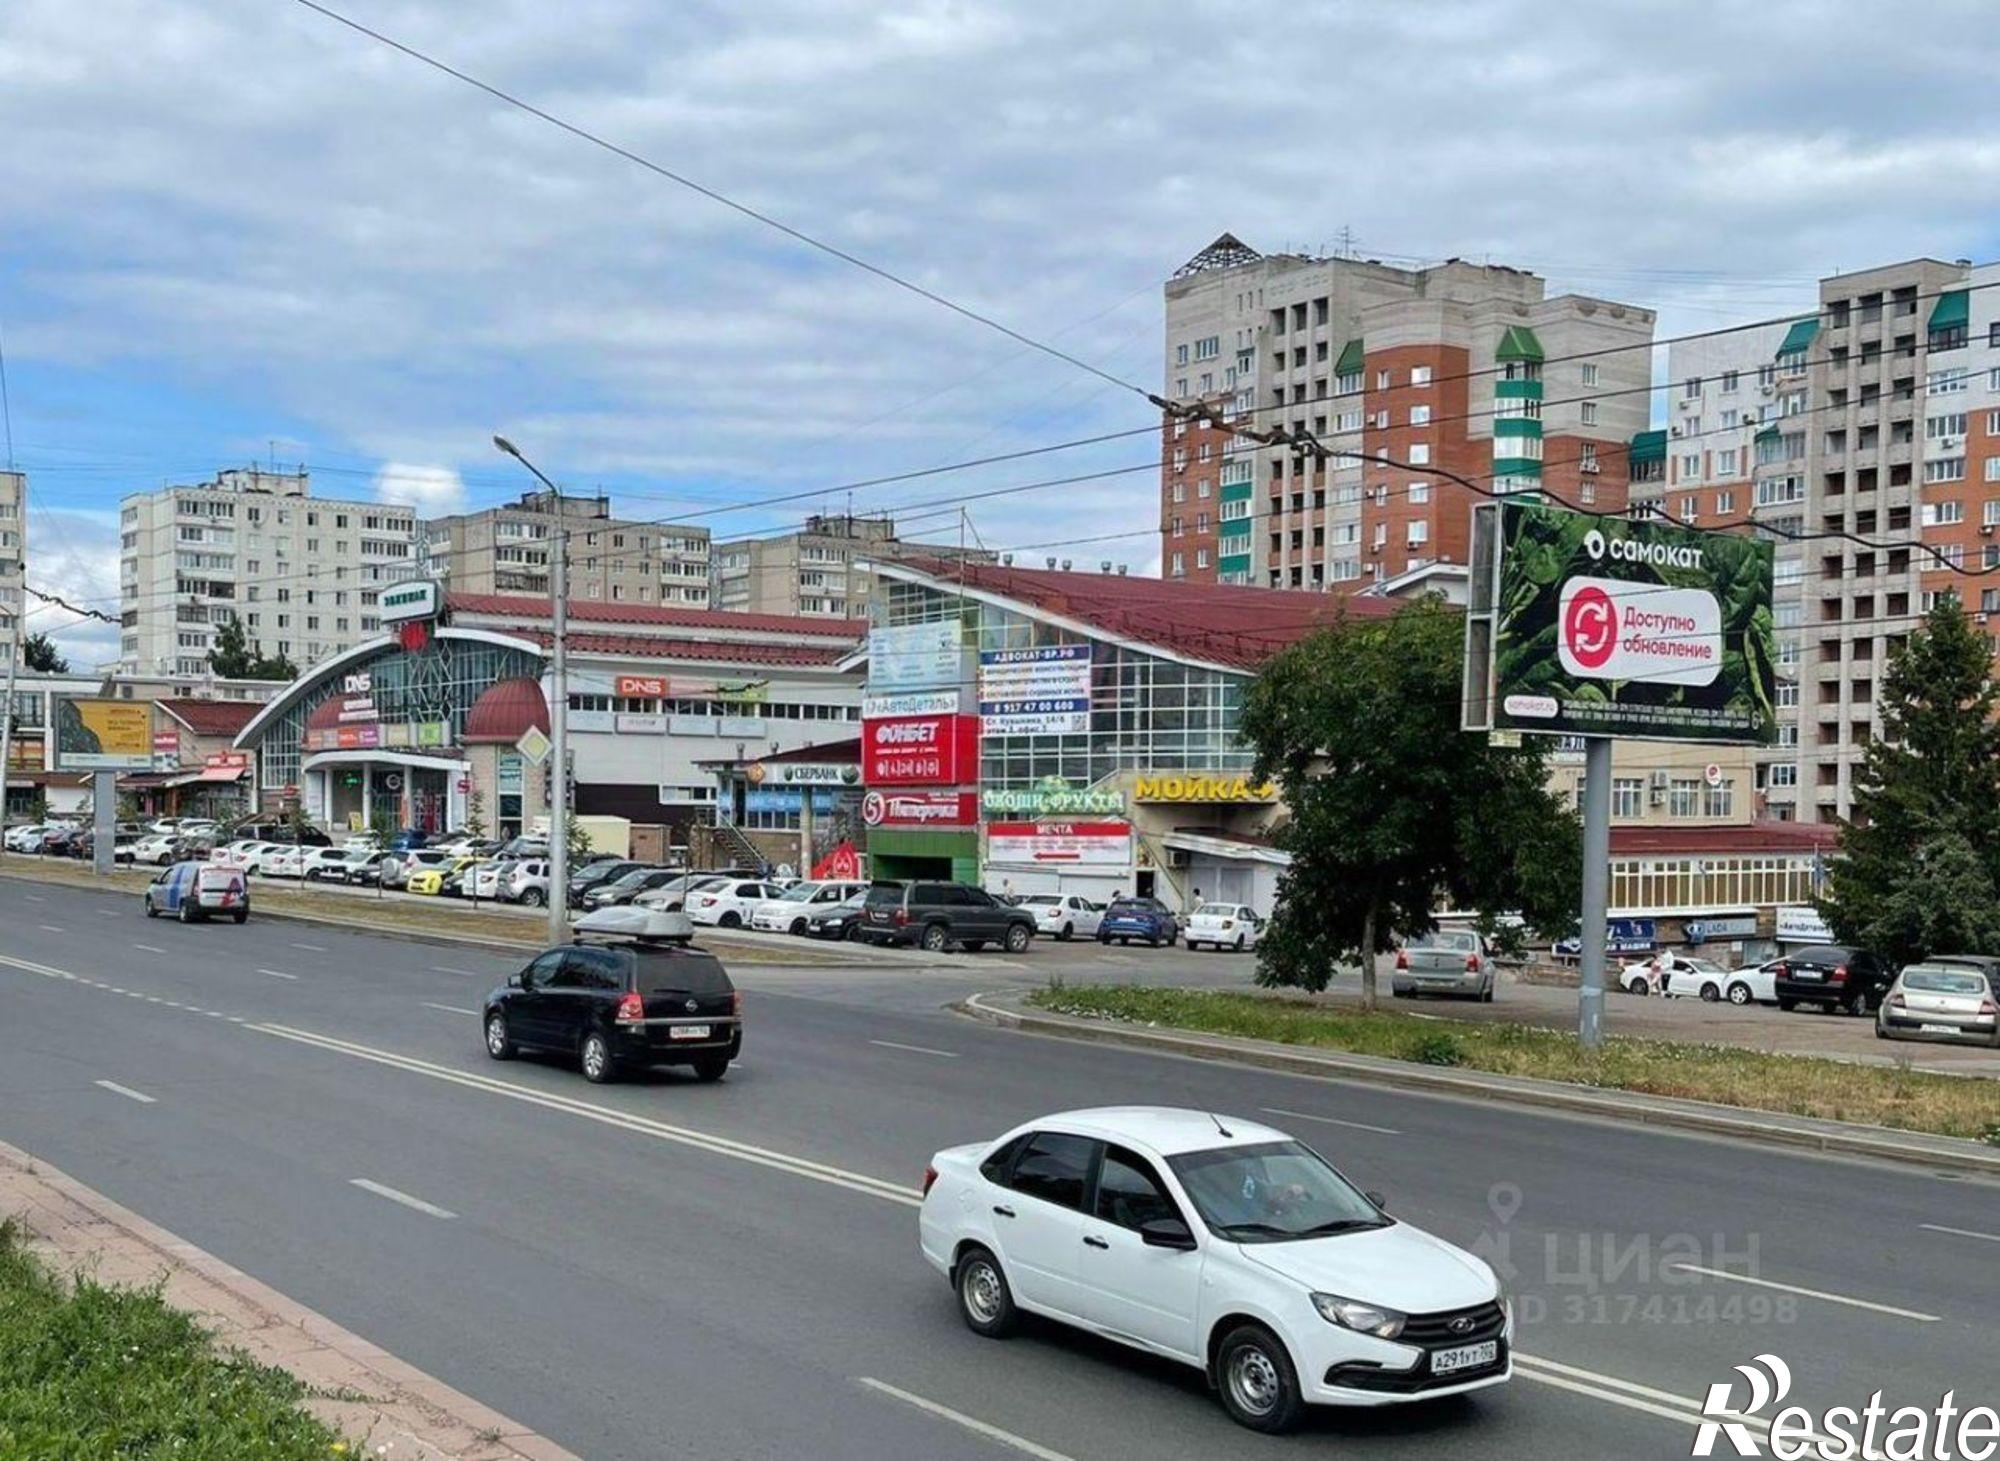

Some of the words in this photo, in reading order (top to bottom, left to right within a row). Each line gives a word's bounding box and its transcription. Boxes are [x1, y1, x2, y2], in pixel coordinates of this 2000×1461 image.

[1610, 539, 1703, 569] самокат
[1623, 606, 1696, 634] Доступно
[1623, 634, 1712, 659] обновление
[345, 674, 371, 693] DNS
[622, 679, 662, 694] DNS
[876, 722, 940, 744] ФОНБЕТ
[794, 767, 838, 780] СБЕРБАНК
[1135, 775, 1249, 800] МОЙКА
[1036, 824, 1074, 835] МЕЧТА
